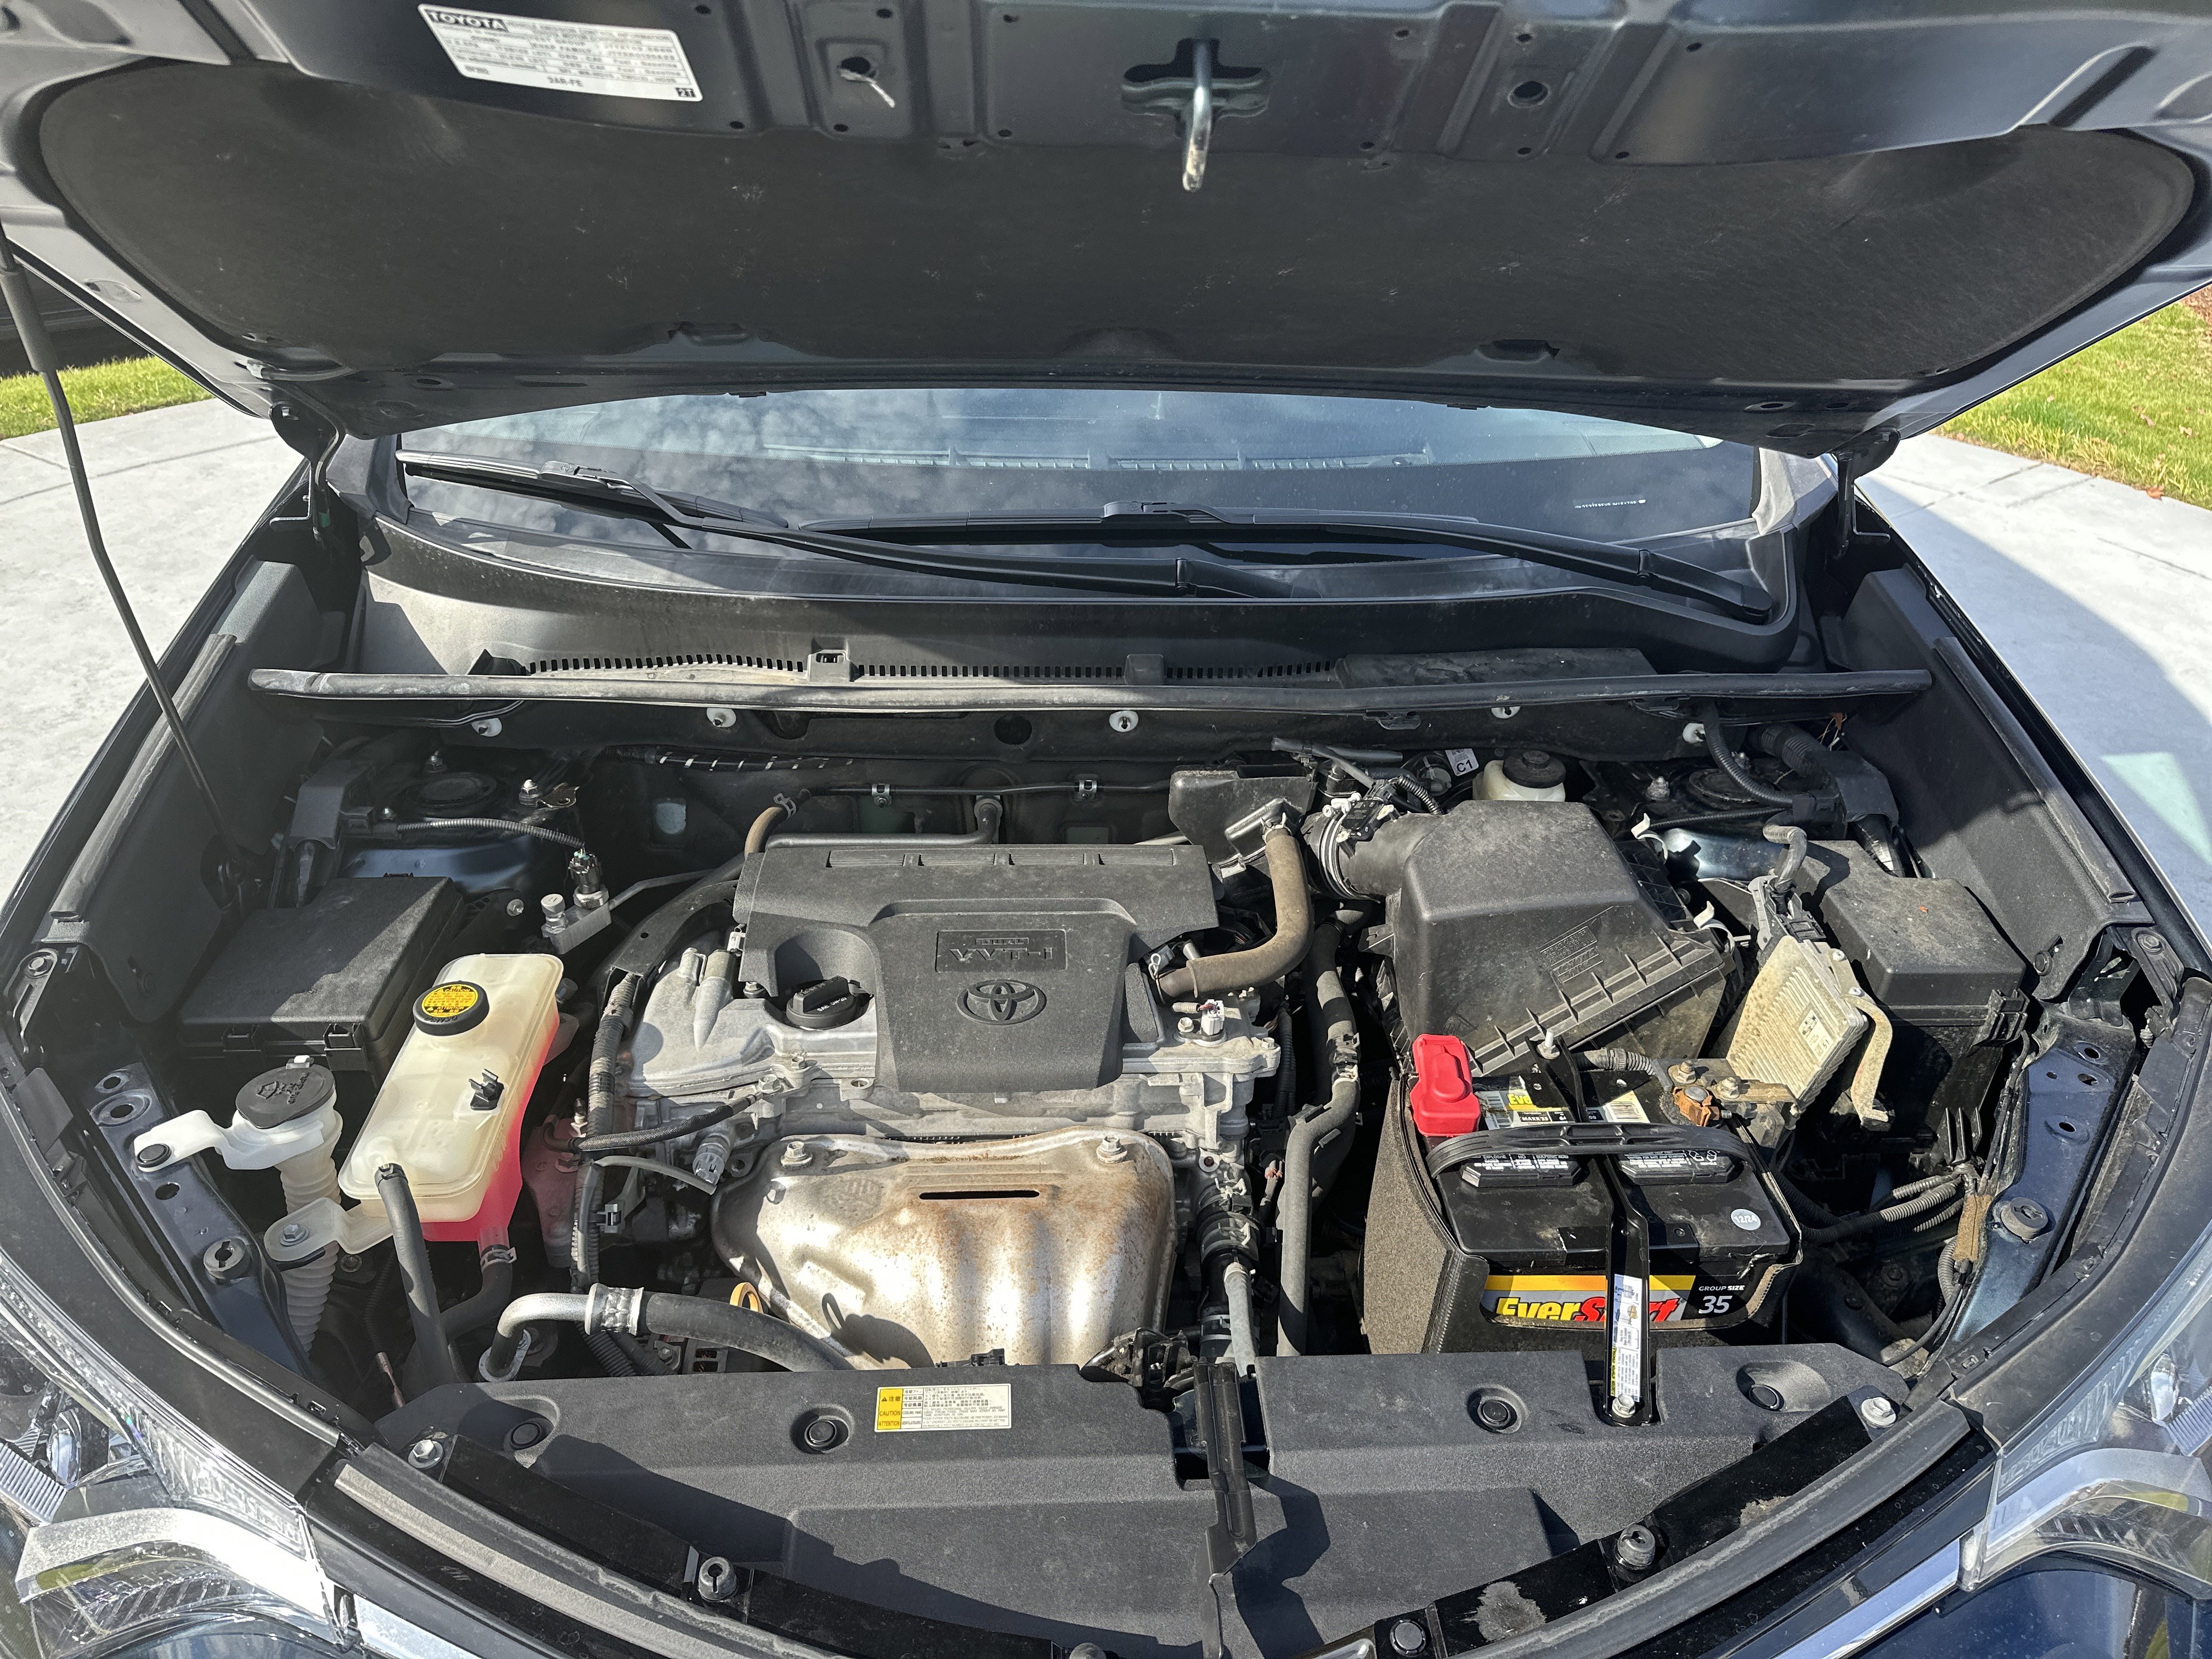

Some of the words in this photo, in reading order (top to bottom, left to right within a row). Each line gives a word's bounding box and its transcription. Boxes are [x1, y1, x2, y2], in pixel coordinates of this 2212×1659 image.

[429, 12, 506, 29] TOYOTA
[546, 77, 584, 86] 2AR-FE
[1457, 759, 1472, 772] C1
[1822, 1039, 1830, 1049] 51
[1734, 1215, 1758, 1223] 12/24
[1497, 1296, 1679, 1322] EverSrt
[1699, 1295, 1733, 1313] 35
